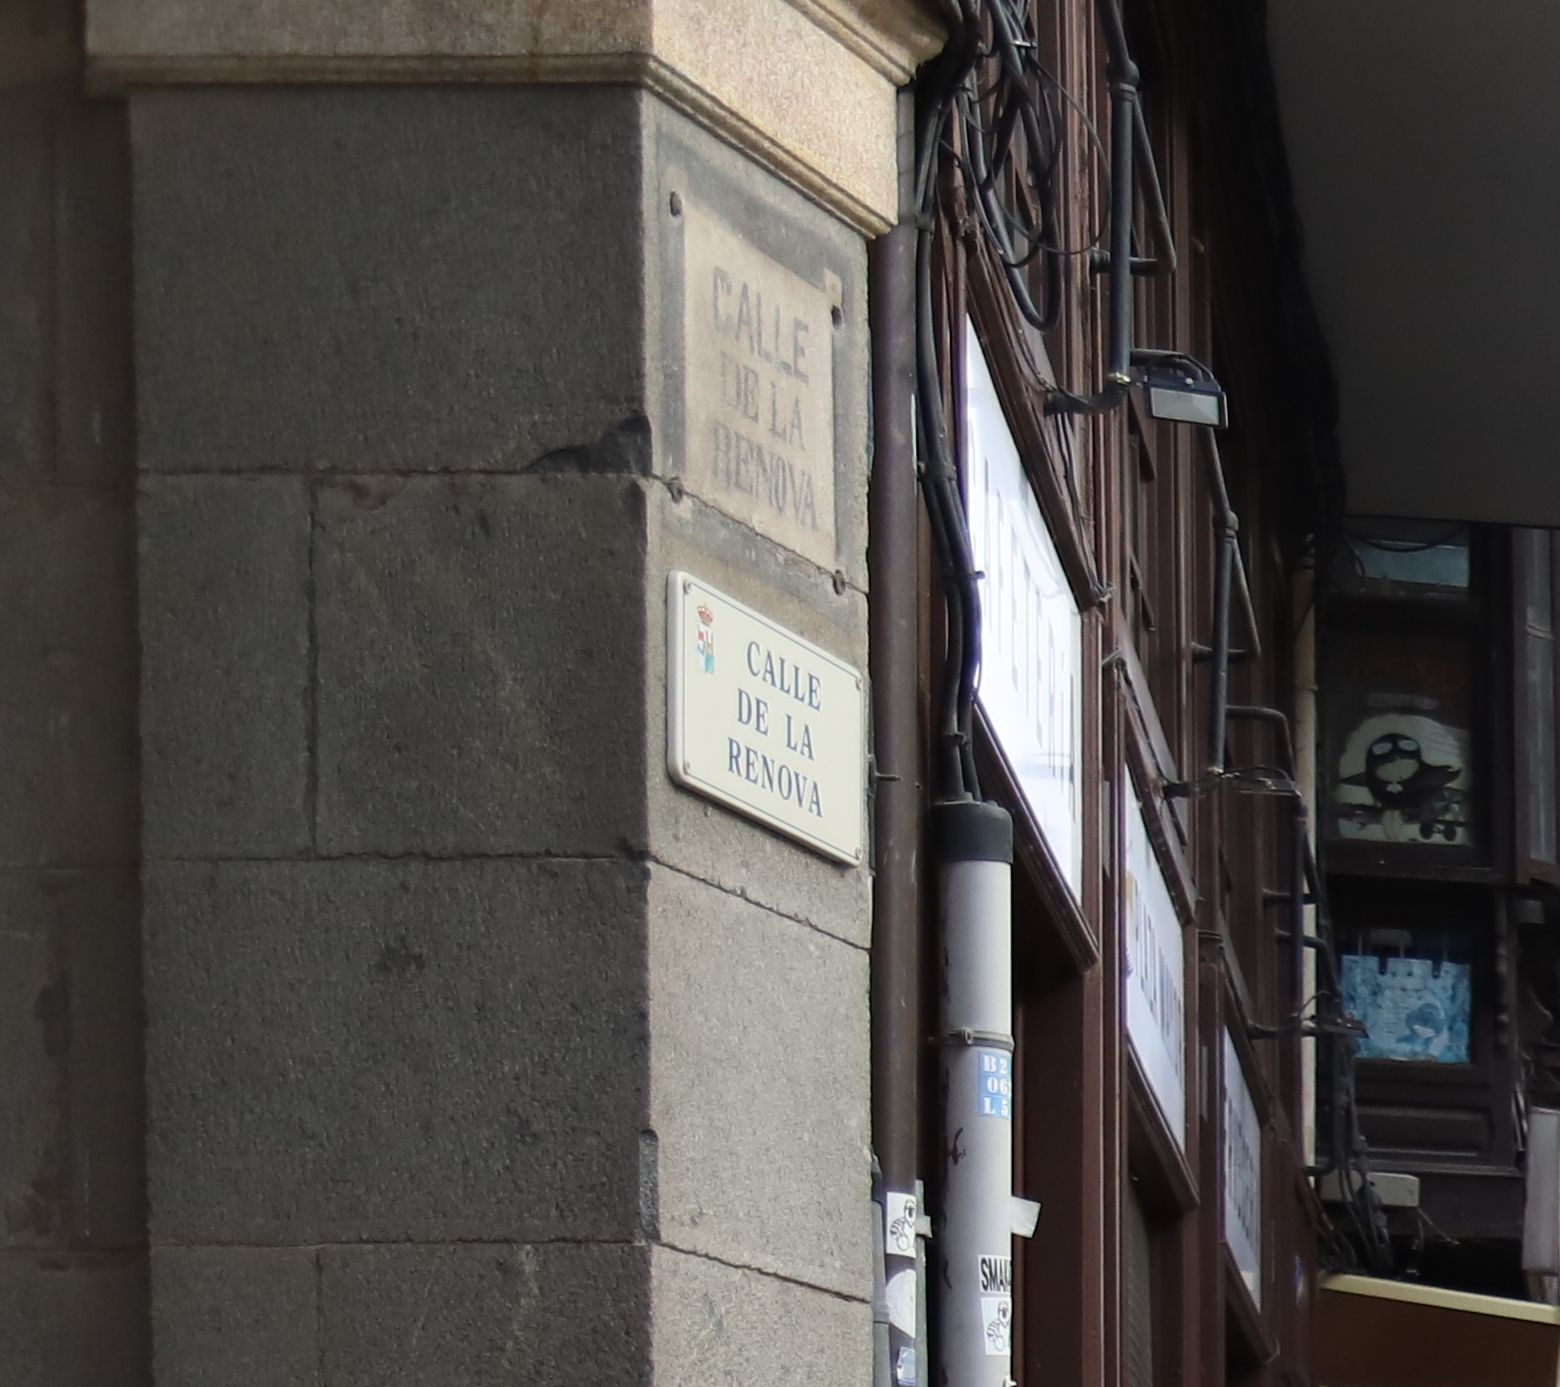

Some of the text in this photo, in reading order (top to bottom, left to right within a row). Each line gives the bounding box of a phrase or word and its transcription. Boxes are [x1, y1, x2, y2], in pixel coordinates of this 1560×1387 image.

[711, 265, 810, 384] CALLE
[719, 350, 807, 452] DE LA
[712, 419, 821, 531] RENOVA
[746, 640, 822, 711] CALLE
[736, 687, 815, 761] DE LA
[726, 736, 823, 818] RENOVA
